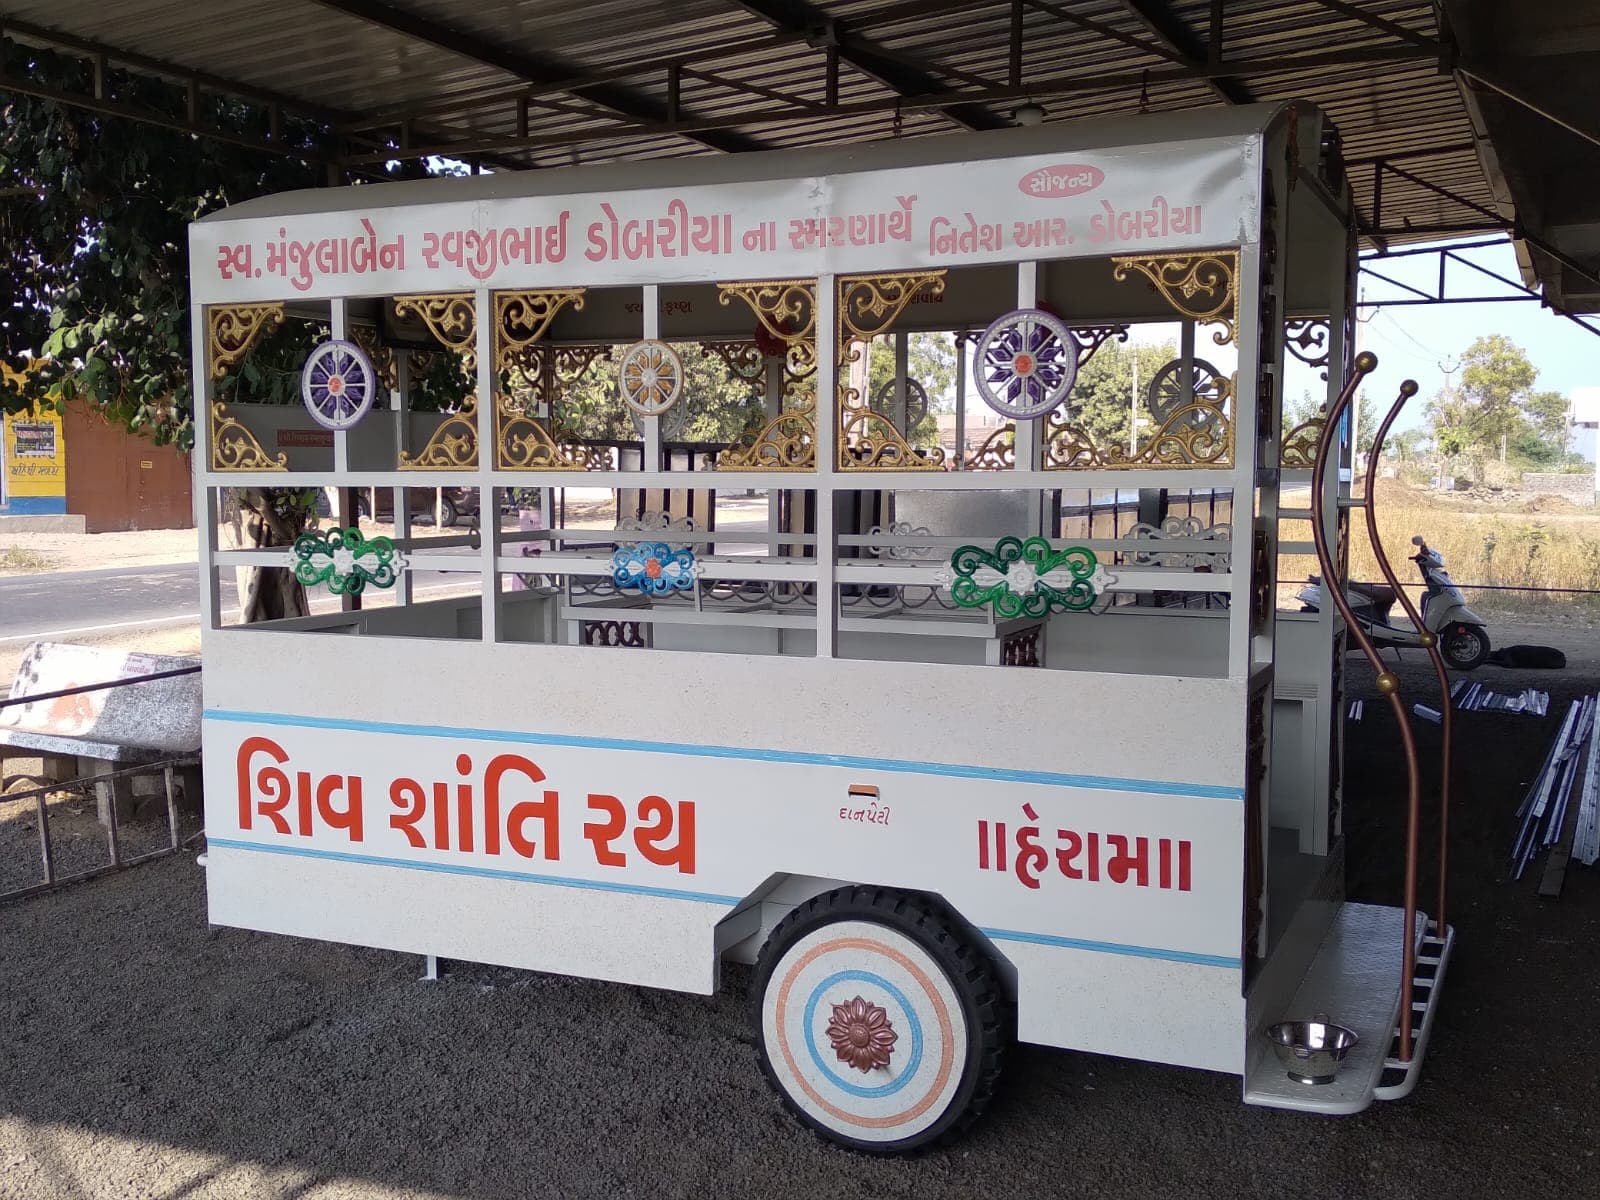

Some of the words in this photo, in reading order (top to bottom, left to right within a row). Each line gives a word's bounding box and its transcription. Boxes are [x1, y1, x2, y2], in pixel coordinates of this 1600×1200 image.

[422, 210, 570, 280] રવજીભાઈ
[584, 198, 732, 262] ડોબરીયા
[743, 222, 776, 251] ના
[788, 195, 918, 249] સ્મરણાર્થે
[929, 212, 1003, 257] નિતેશ
[1013, 217, 1074, 247] આર.
[1087, 195, 1202, 243] ડોબરીયા
[236, 736, 364, 843] શિવ
[389, 753, 560, 861] શાંતિ
[583, 793, 697, 875] રથ
